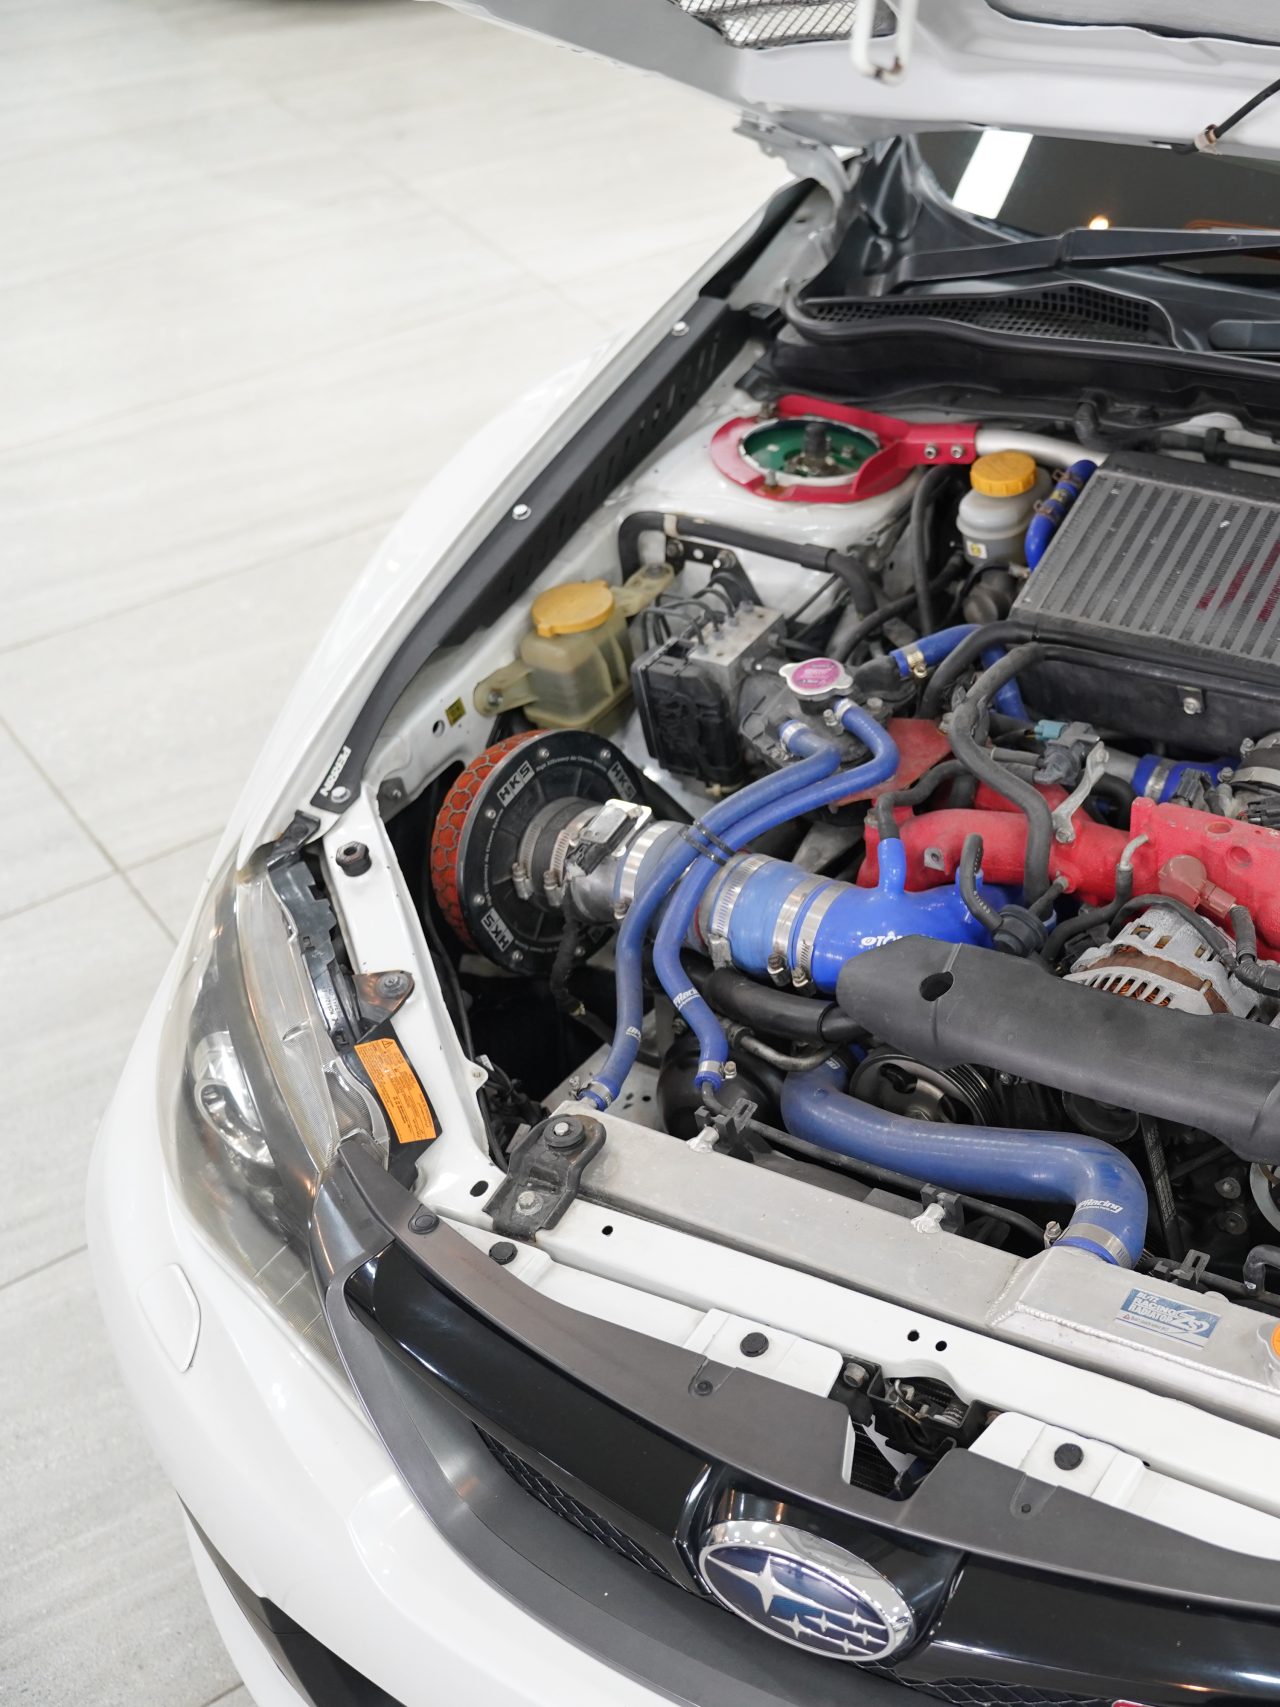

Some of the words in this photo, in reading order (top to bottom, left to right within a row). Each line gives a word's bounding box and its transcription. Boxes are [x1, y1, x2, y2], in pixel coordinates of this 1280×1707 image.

[319, 745, 352, 797] PERRIN
[498, 761, 533, 804] HKS
[610, 763, 636, 799] HKS
[482, 911, 512, 951] HKS
[1128, 1304, 1175, 1323] RADIATOR
[1133, 1297, 1177, 1318] RACING
